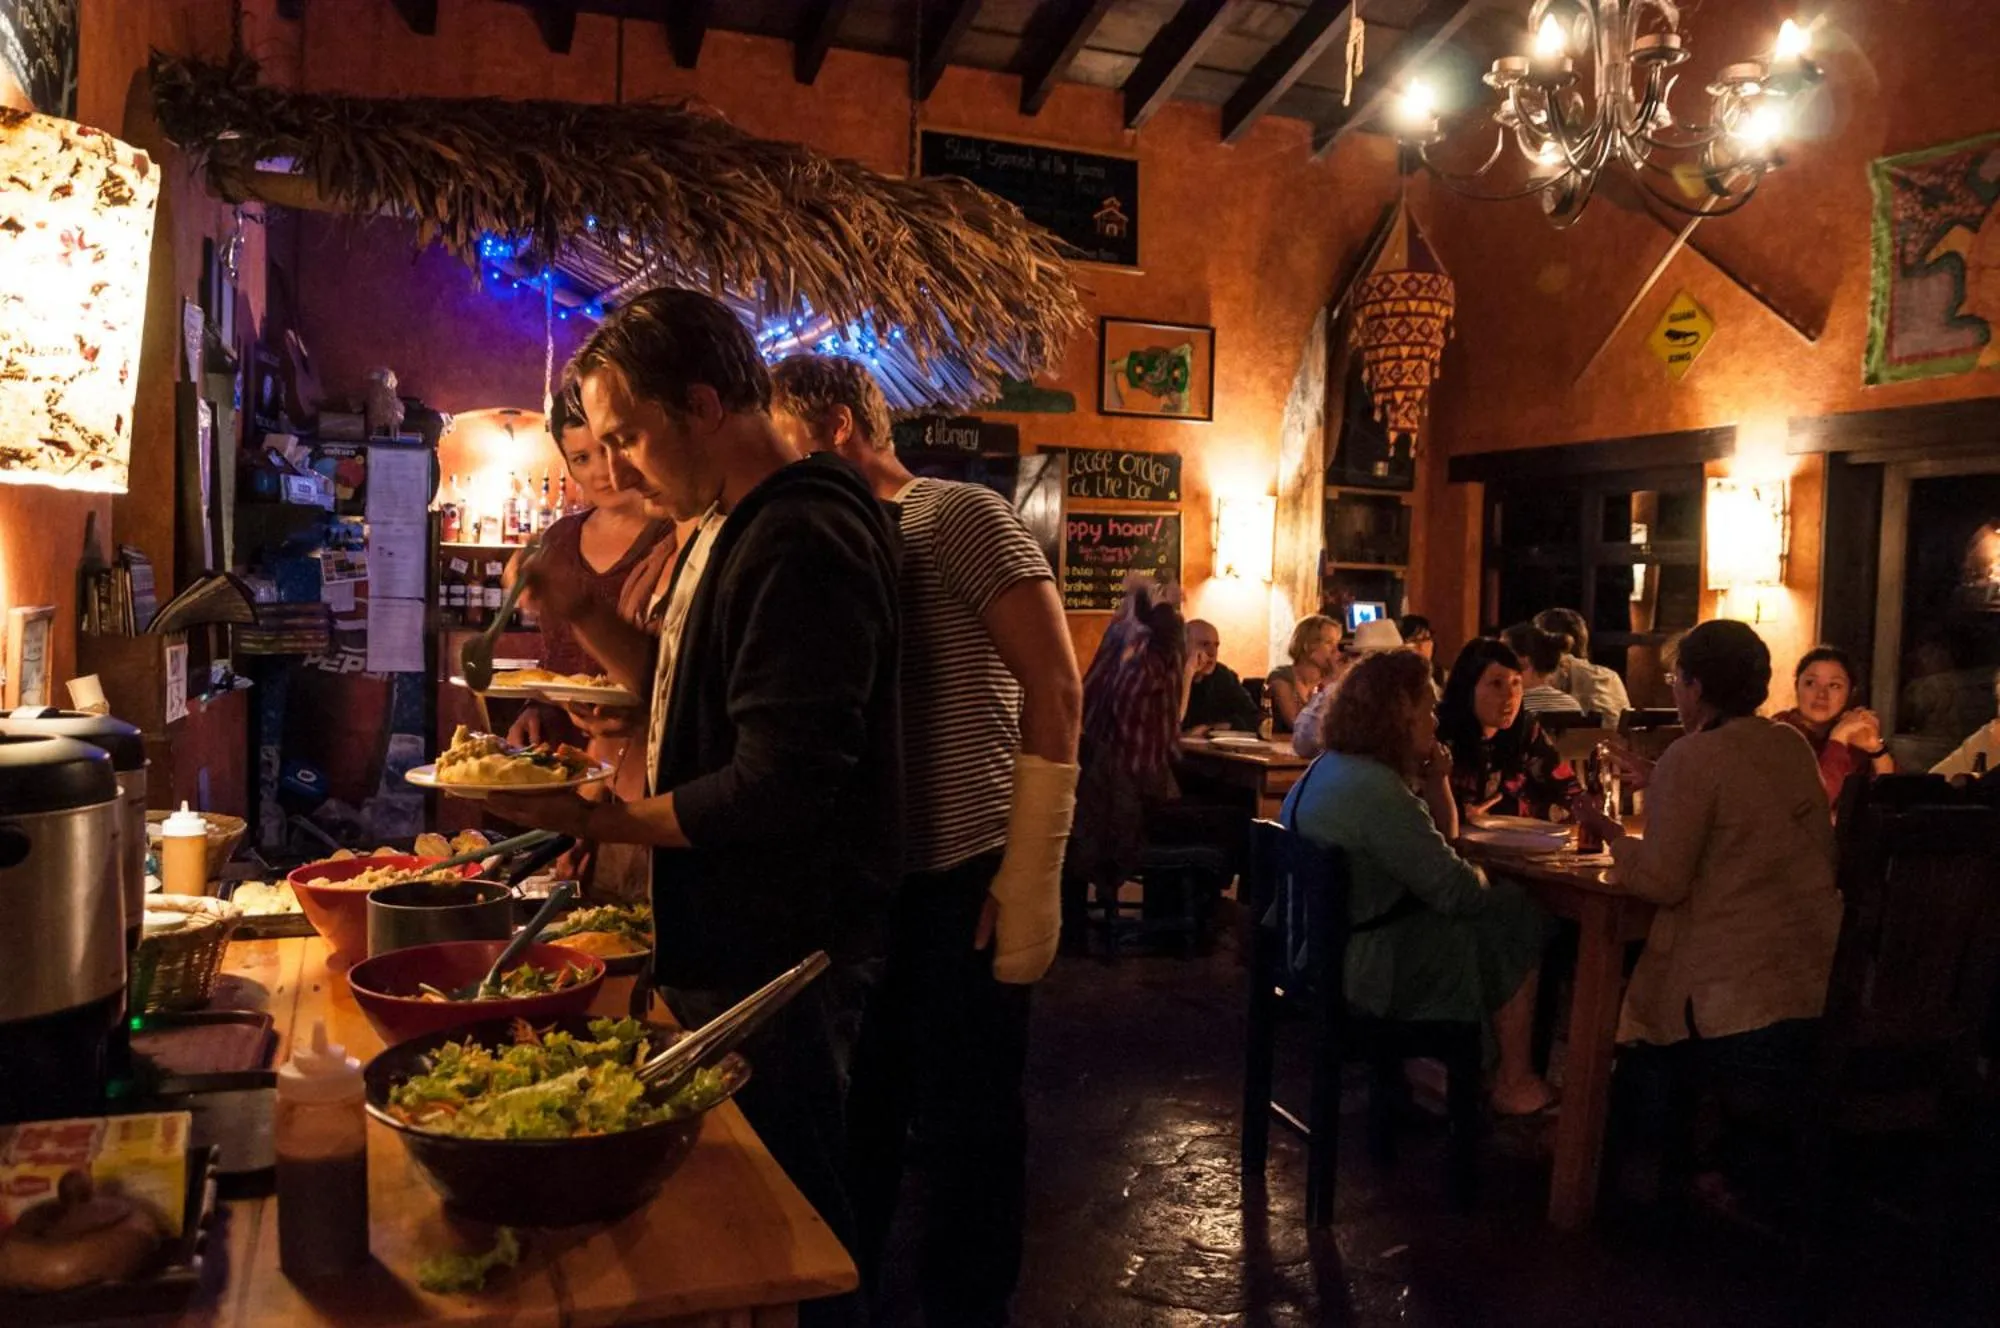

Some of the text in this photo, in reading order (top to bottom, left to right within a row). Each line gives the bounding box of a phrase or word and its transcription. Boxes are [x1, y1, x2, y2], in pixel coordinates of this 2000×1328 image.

[1066, 448, 1171, 488] lease Order
[1071, 477, 1090, 496] at
[1095, 471, 1122, 497] the
[1066, 520, 1102, 544] ppy
